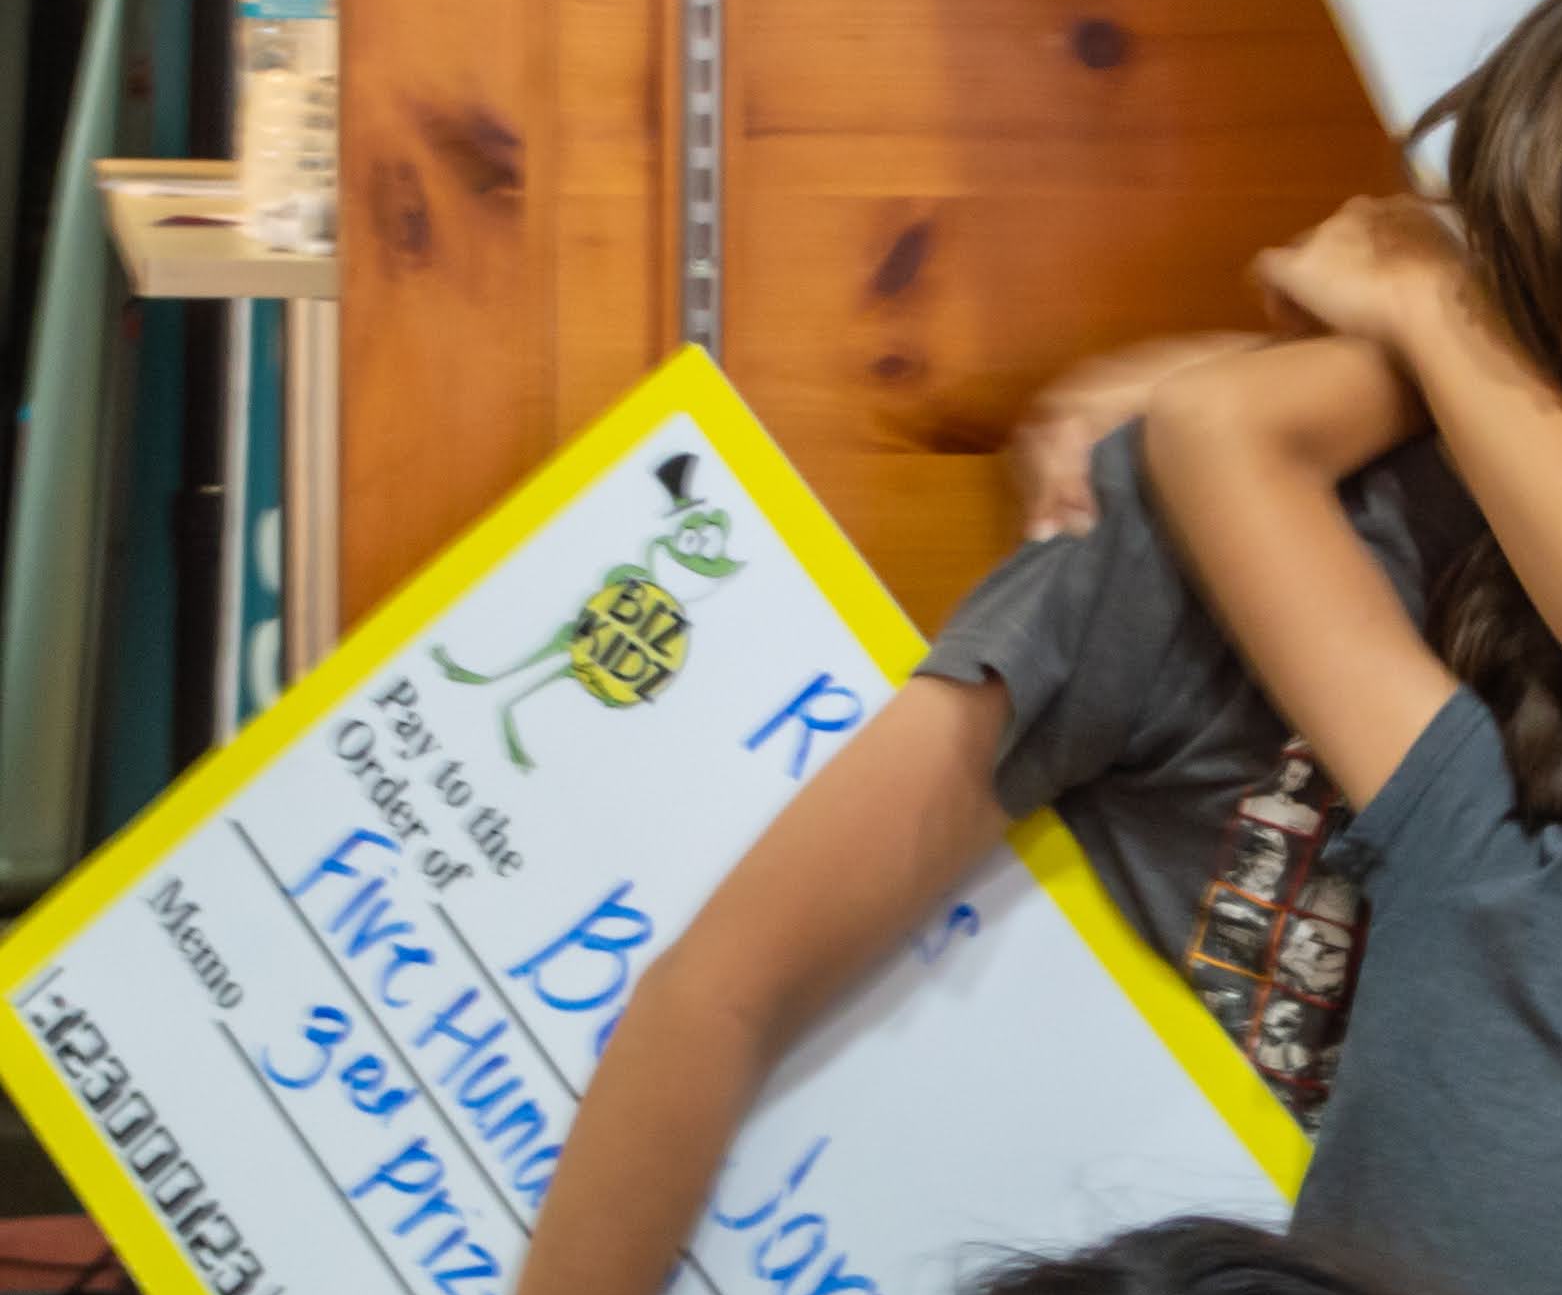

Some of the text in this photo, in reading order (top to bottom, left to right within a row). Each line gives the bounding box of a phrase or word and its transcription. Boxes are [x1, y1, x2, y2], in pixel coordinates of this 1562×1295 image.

[572, 612, 675, 704] KIDZ
[605, 578, 692, 657] BIZ
[333, 718, 474, 893] Order of
[372, 678, 524, 878] Pay to the
[145, 876, 245, 1010] Memo
[287, 827, 434, 1008] Five
